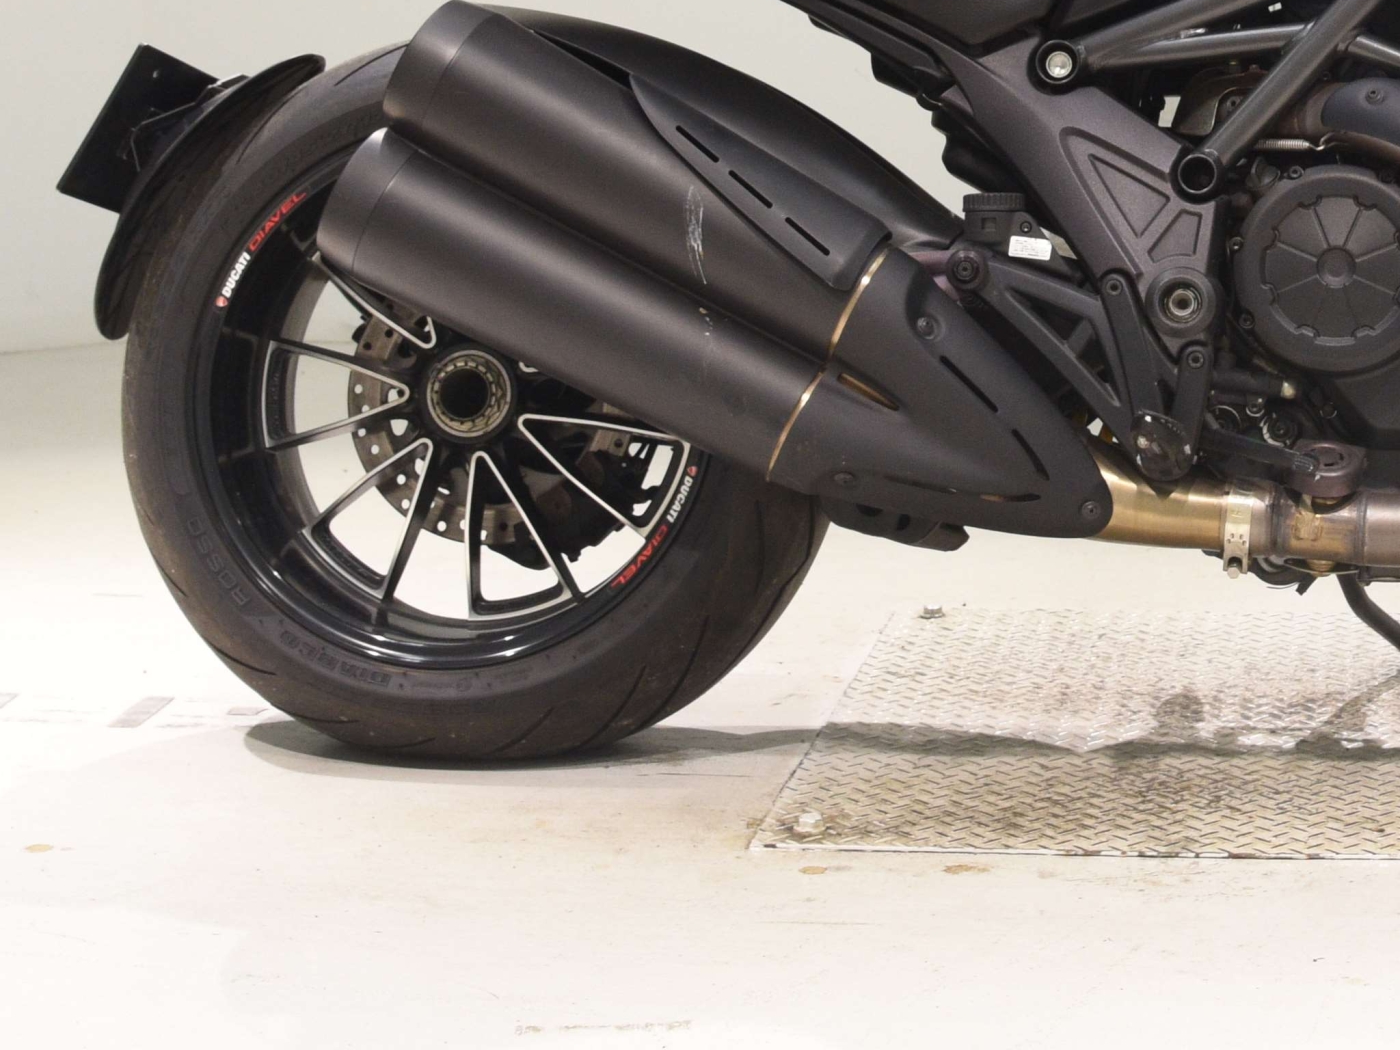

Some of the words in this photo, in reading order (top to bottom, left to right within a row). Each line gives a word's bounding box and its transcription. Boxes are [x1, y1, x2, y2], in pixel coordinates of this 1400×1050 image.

[221, 251, 251, 298] DUCATI
[249, 192, 307, 252] DIAVEL
[666, 475, 693, 523] DUCATI
[610, 524, 669, 588] DIAVEL
